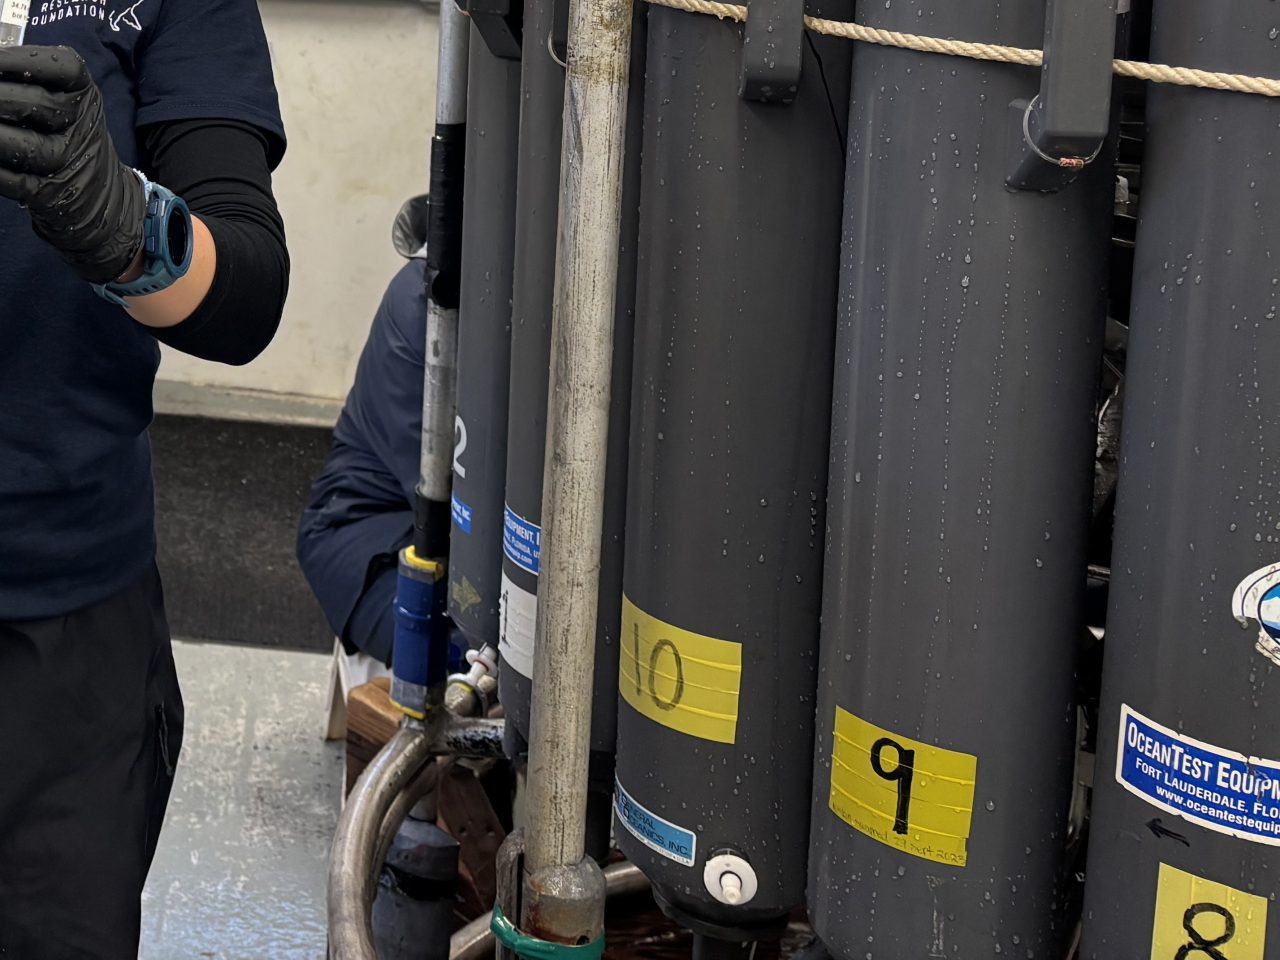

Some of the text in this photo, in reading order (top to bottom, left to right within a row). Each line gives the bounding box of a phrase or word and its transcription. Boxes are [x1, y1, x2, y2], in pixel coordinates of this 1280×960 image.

[634, 623, 684, 711] 10
[870, 737, 915, 835] 9
[1135, 757, 1162, 781] FORT
[1164, 772, 1249, 813] LAUDERDALE,
